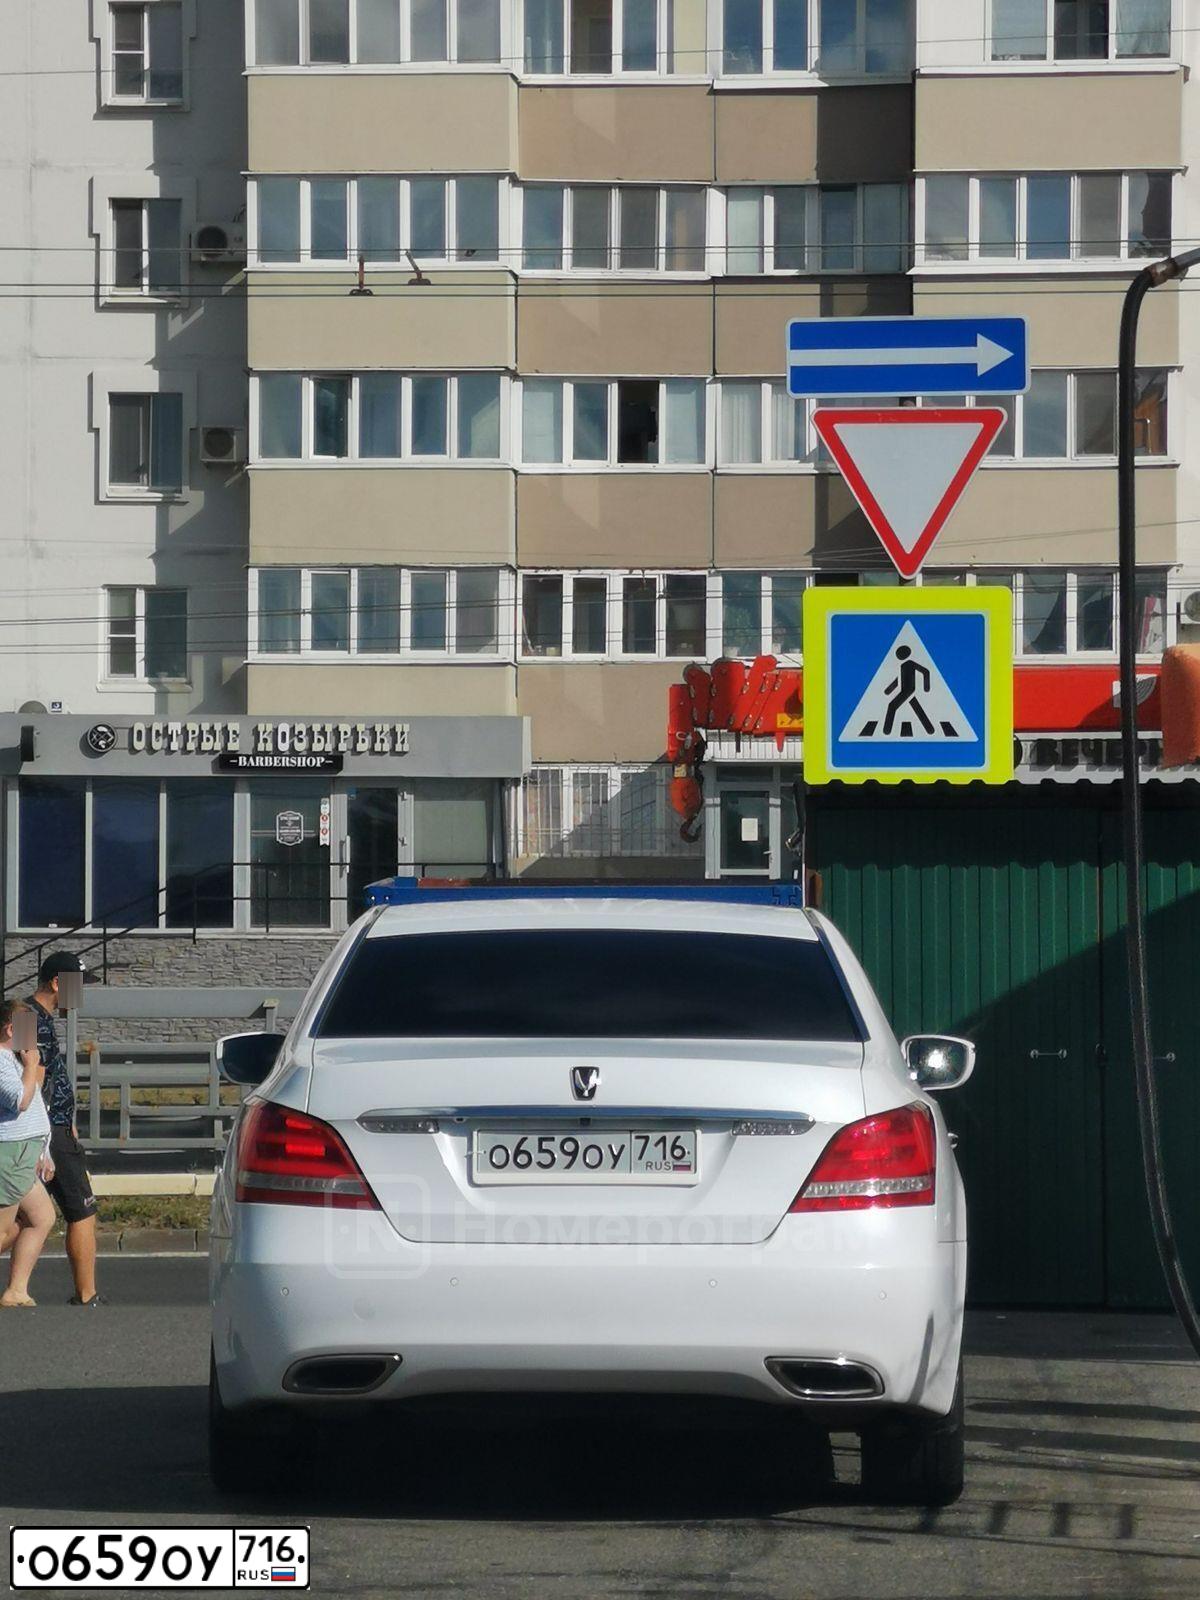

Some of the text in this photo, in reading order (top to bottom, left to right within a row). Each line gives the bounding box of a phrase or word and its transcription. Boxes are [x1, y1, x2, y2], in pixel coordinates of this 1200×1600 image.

[132, 721, 410, 752] ОСТРЫЕ КОЗЫРЬКИ
[634, 1135, 686, 1161] 716
[645, 1161, 671, 1171] RUS
